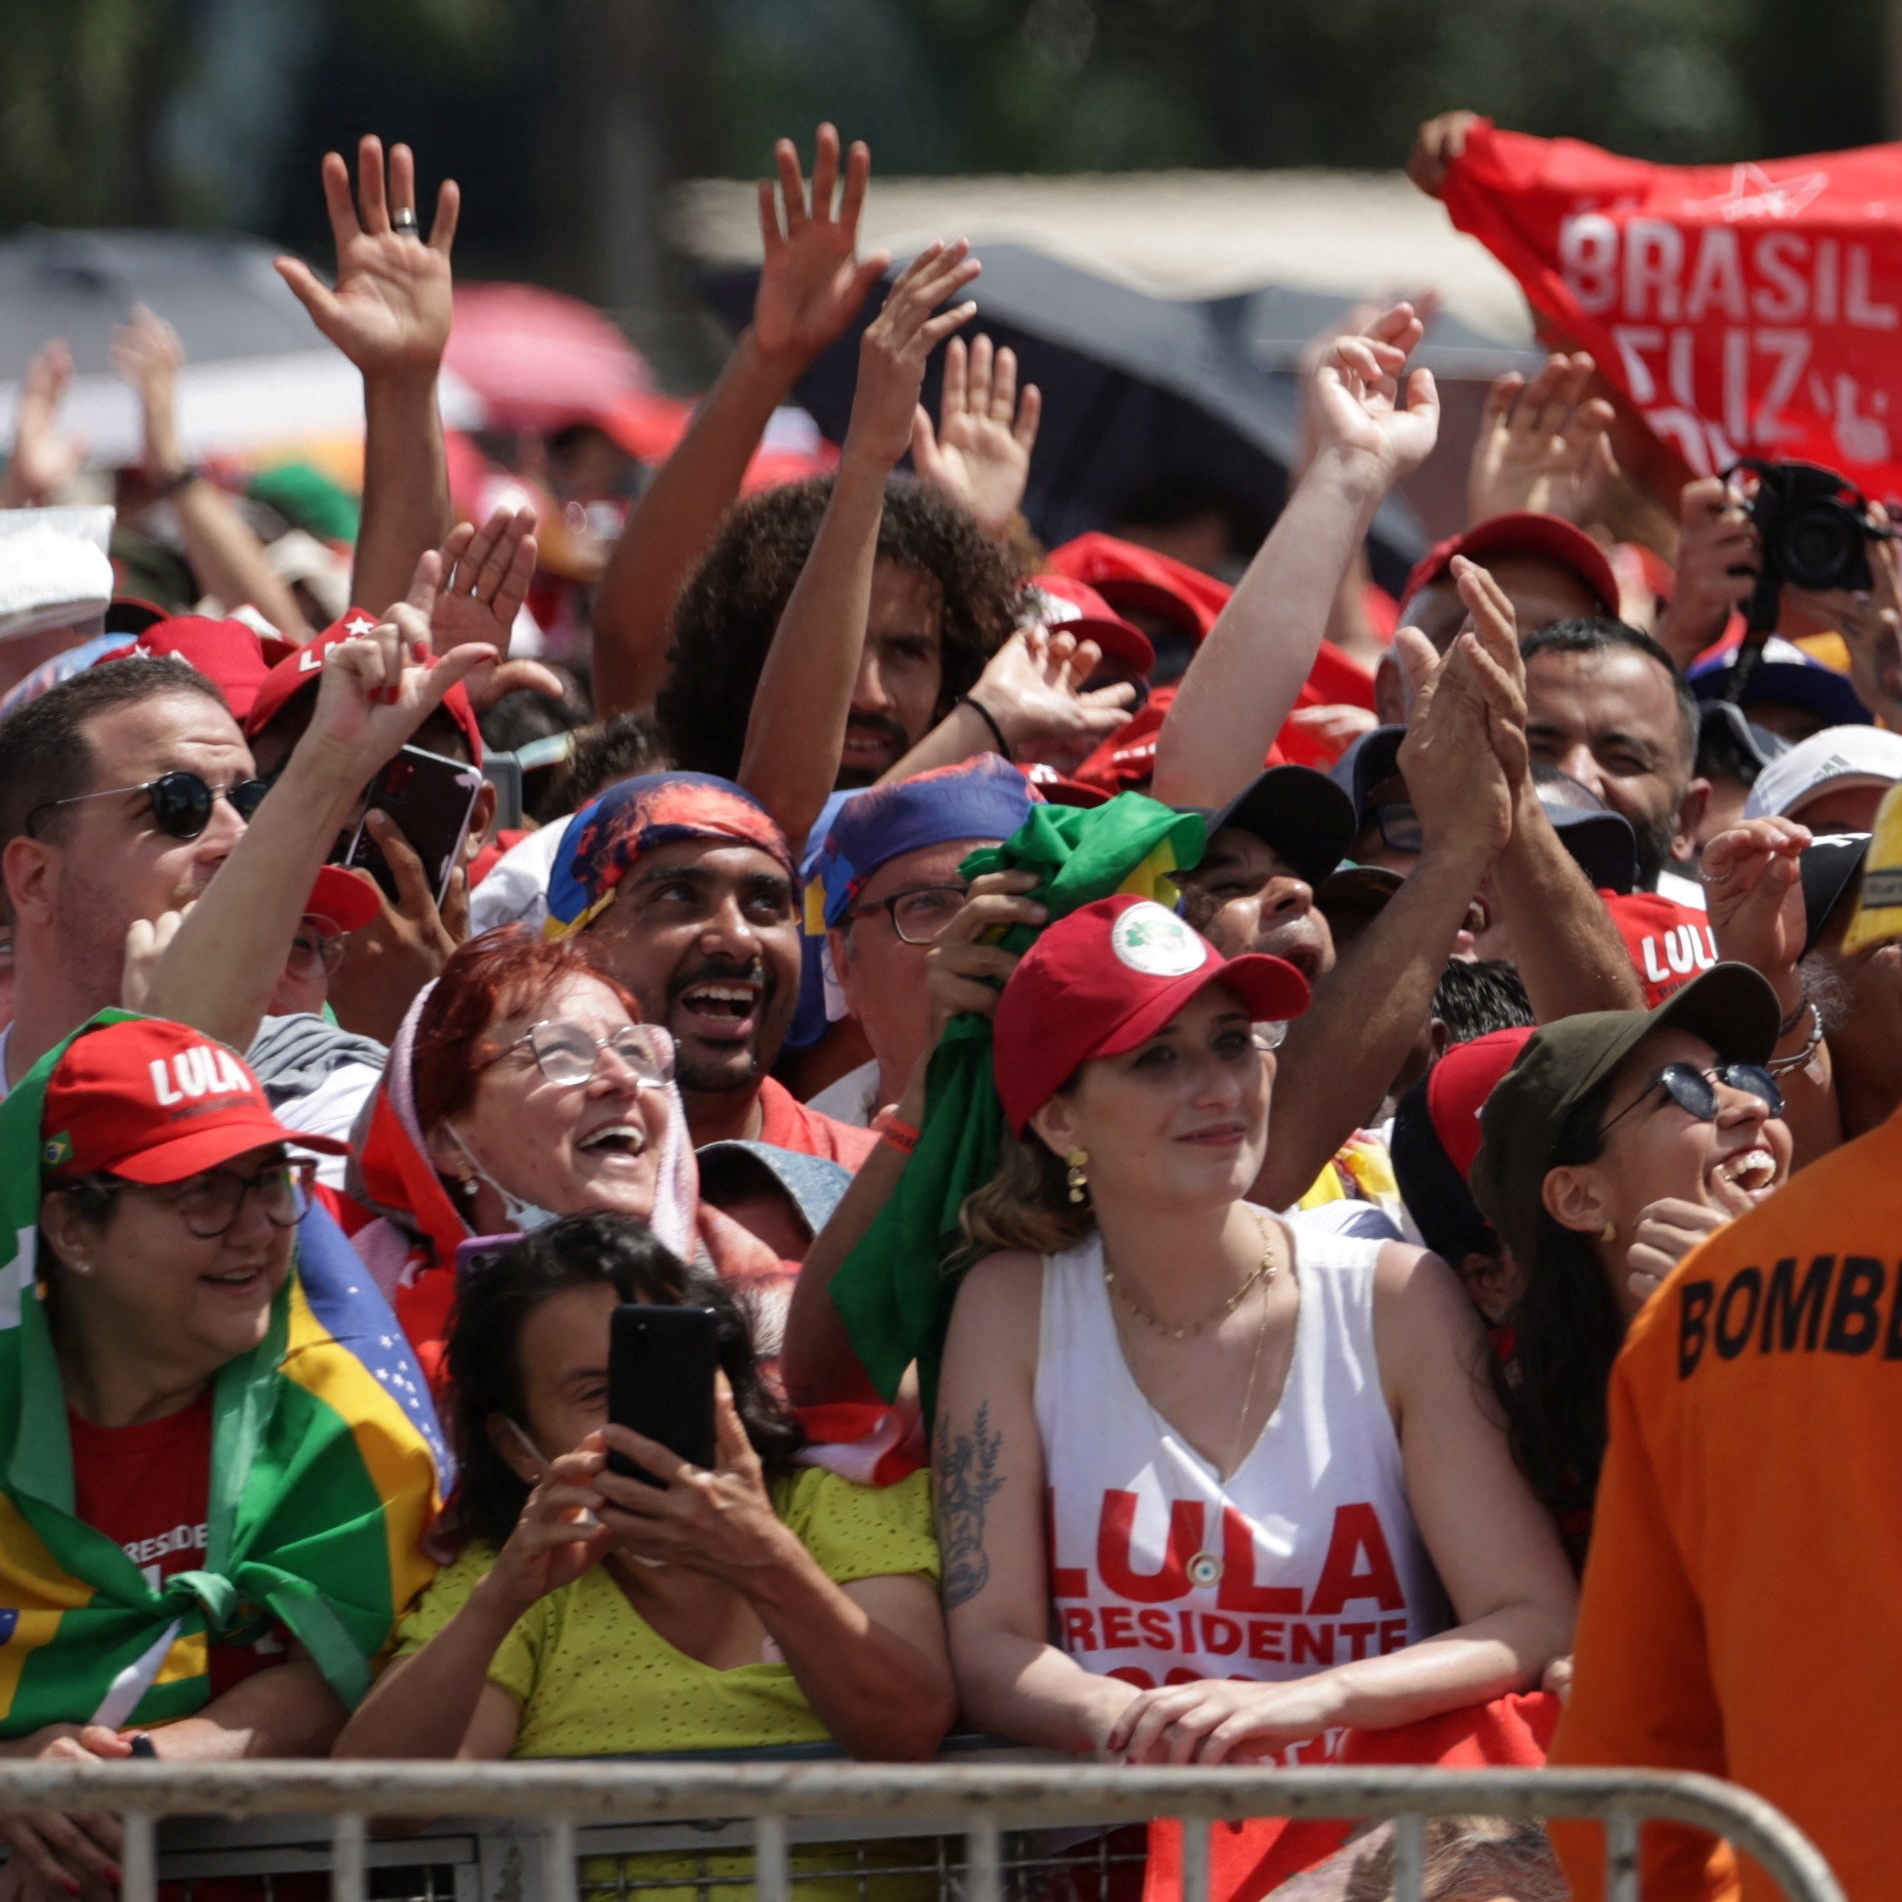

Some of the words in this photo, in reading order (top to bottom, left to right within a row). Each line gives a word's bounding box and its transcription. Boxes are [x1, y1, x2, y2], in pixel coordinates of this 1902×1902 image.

[1557, 211, 1899, 331] BRASIL
[149, 1045, 252, 1106] LULA
[1049, 1486, 1406, 1615] LULA
[1061, 1606, 1407, 1666] RESIDENTE
